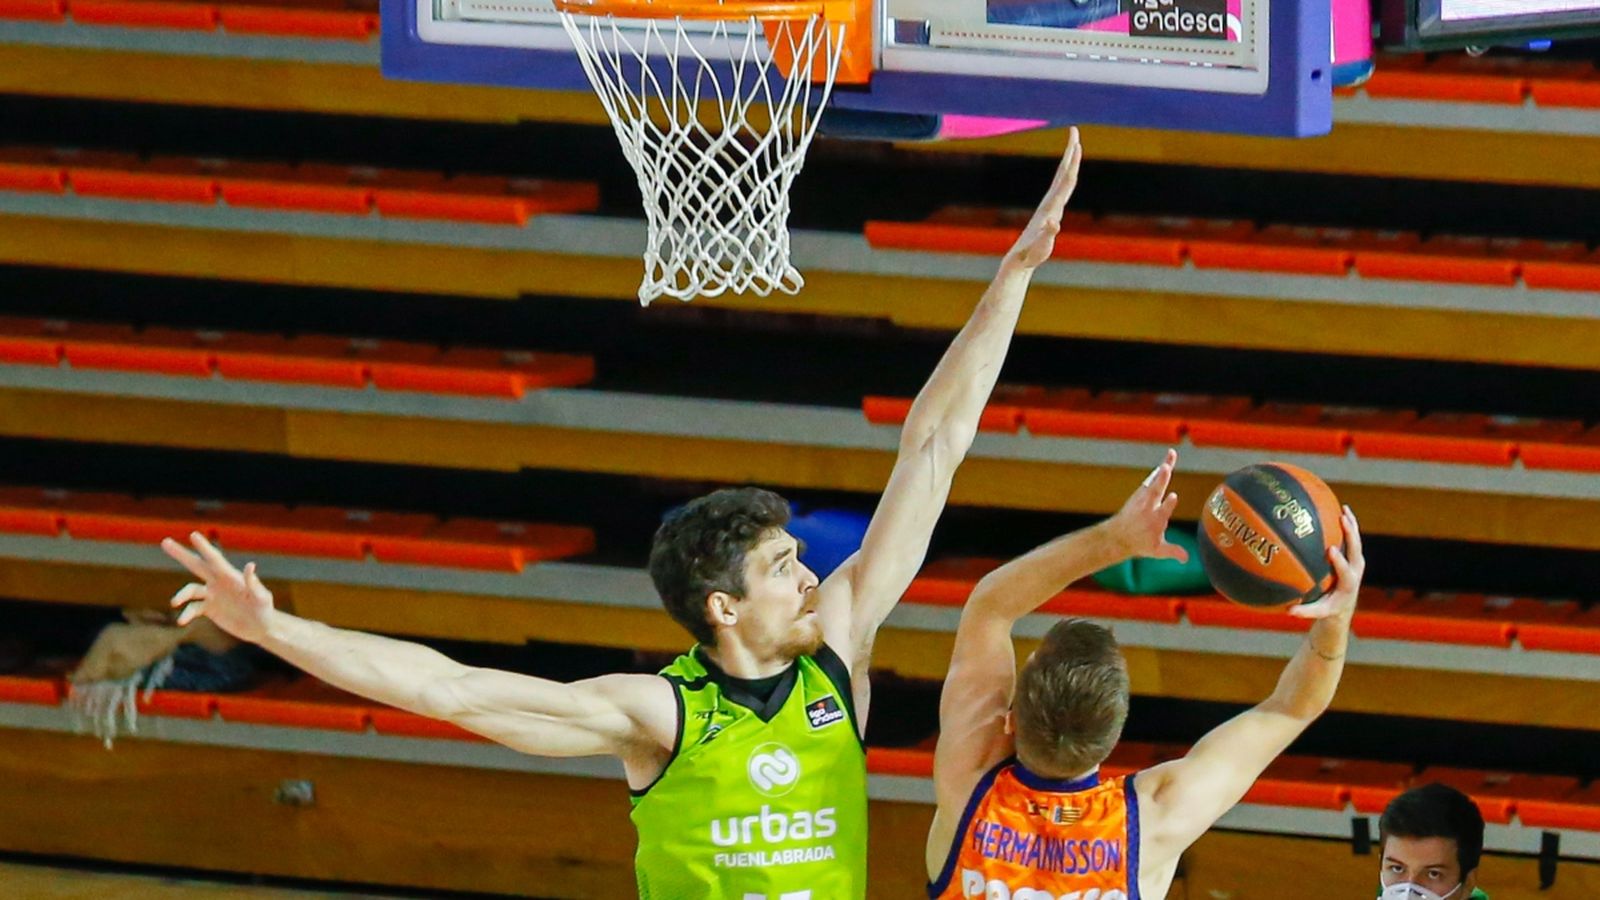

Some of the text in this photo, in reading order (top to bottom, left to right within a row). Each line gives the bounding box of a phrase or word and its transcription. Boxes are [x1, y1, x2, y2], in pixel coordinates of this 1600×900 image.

[1133, 6, 1224, 33] endesa
[711, 805, 837, 847] urbas
[714, 845, 835, 868] FUENLABRADA
[972, 817, 1121, 876] HERMANNSSON
